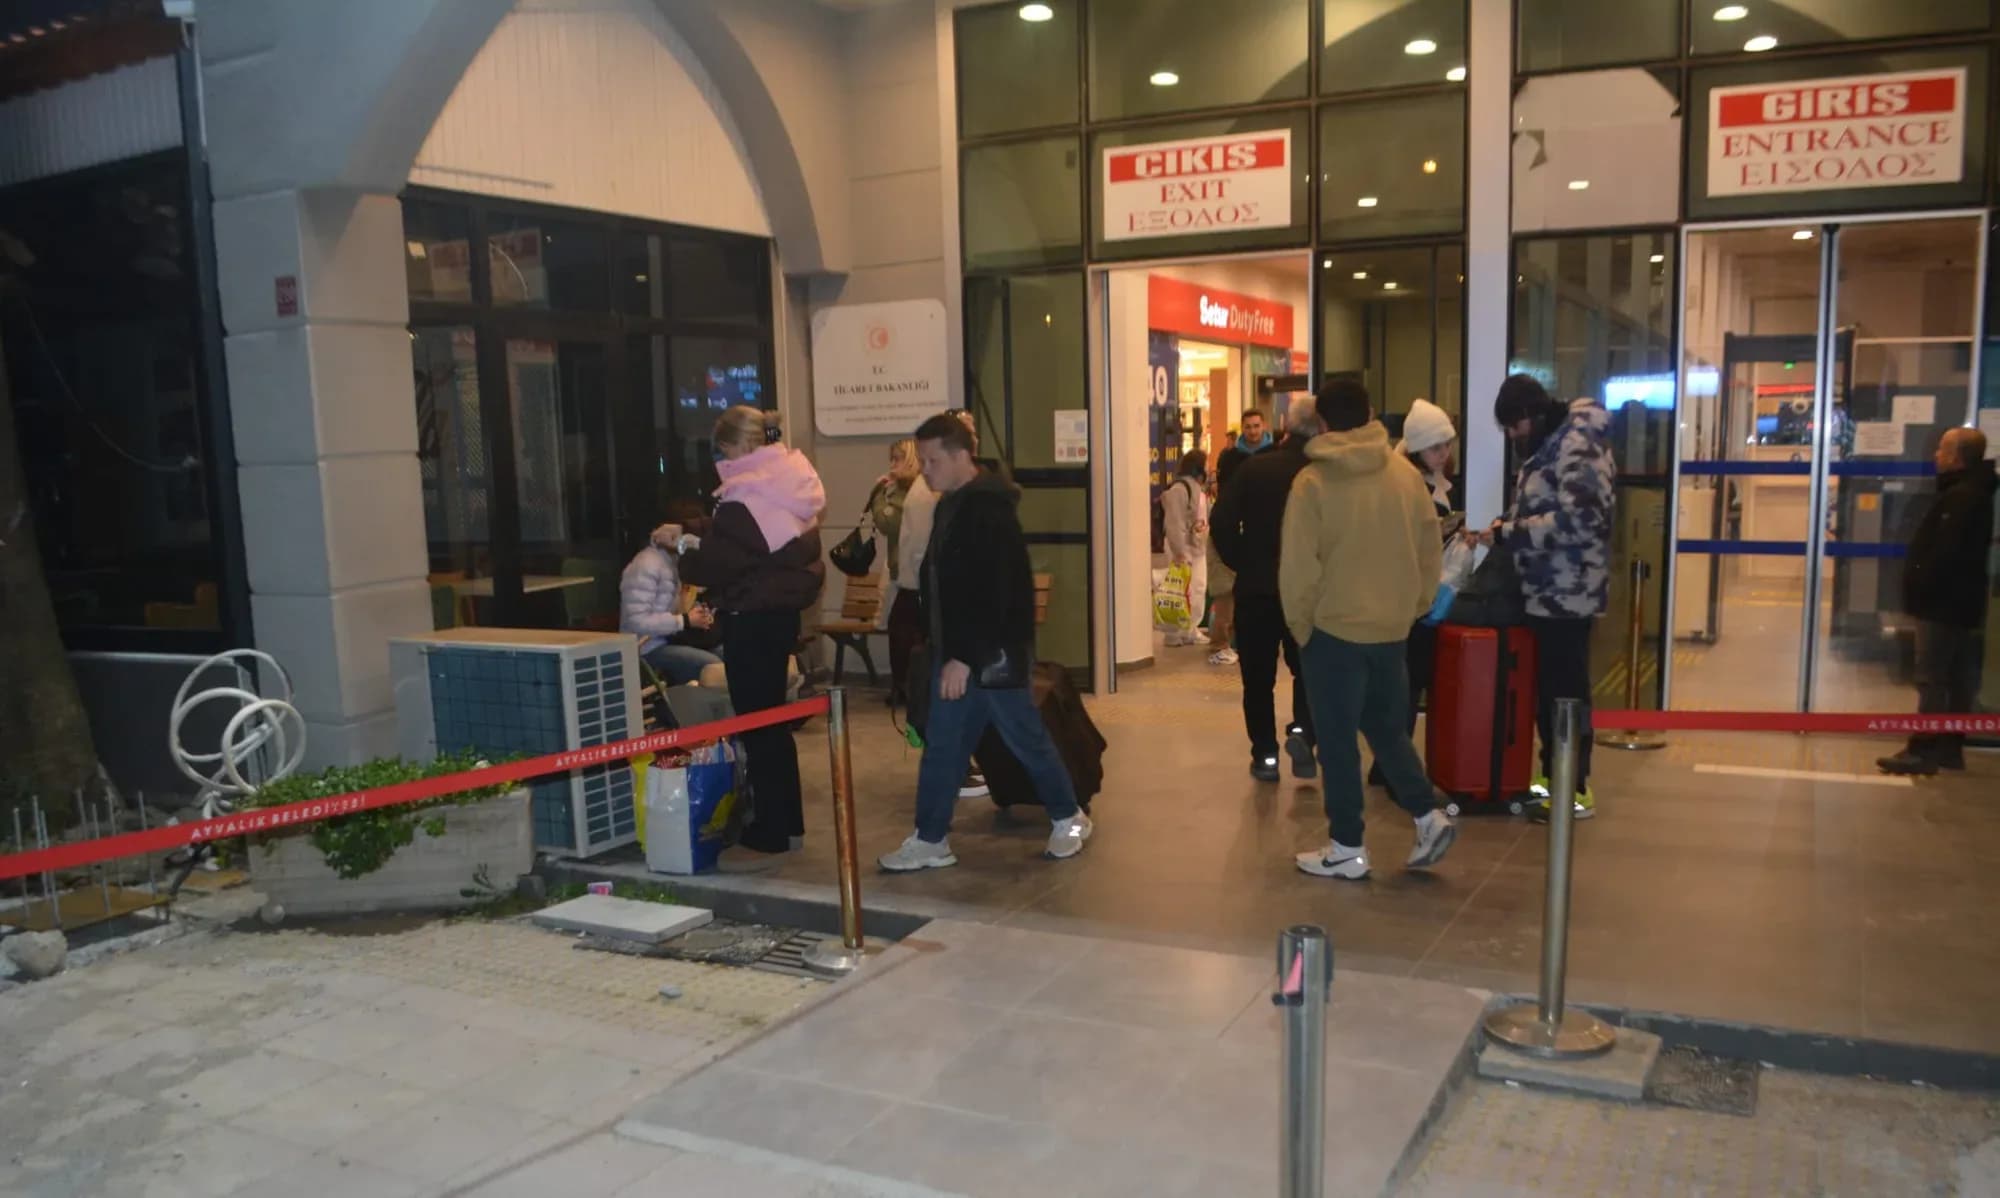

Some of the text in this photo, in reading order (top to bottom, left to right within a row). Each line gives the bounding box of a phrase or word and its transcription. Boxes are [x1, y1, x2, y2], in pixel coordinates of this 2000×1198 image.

[1722, 119, 1951, 158] ENTRANCE
[1161, 178, 1231, 204] EXIT
[556, 747, 609, 767] AYVALIK
[191, 814, 266, 841] AYVALIK
